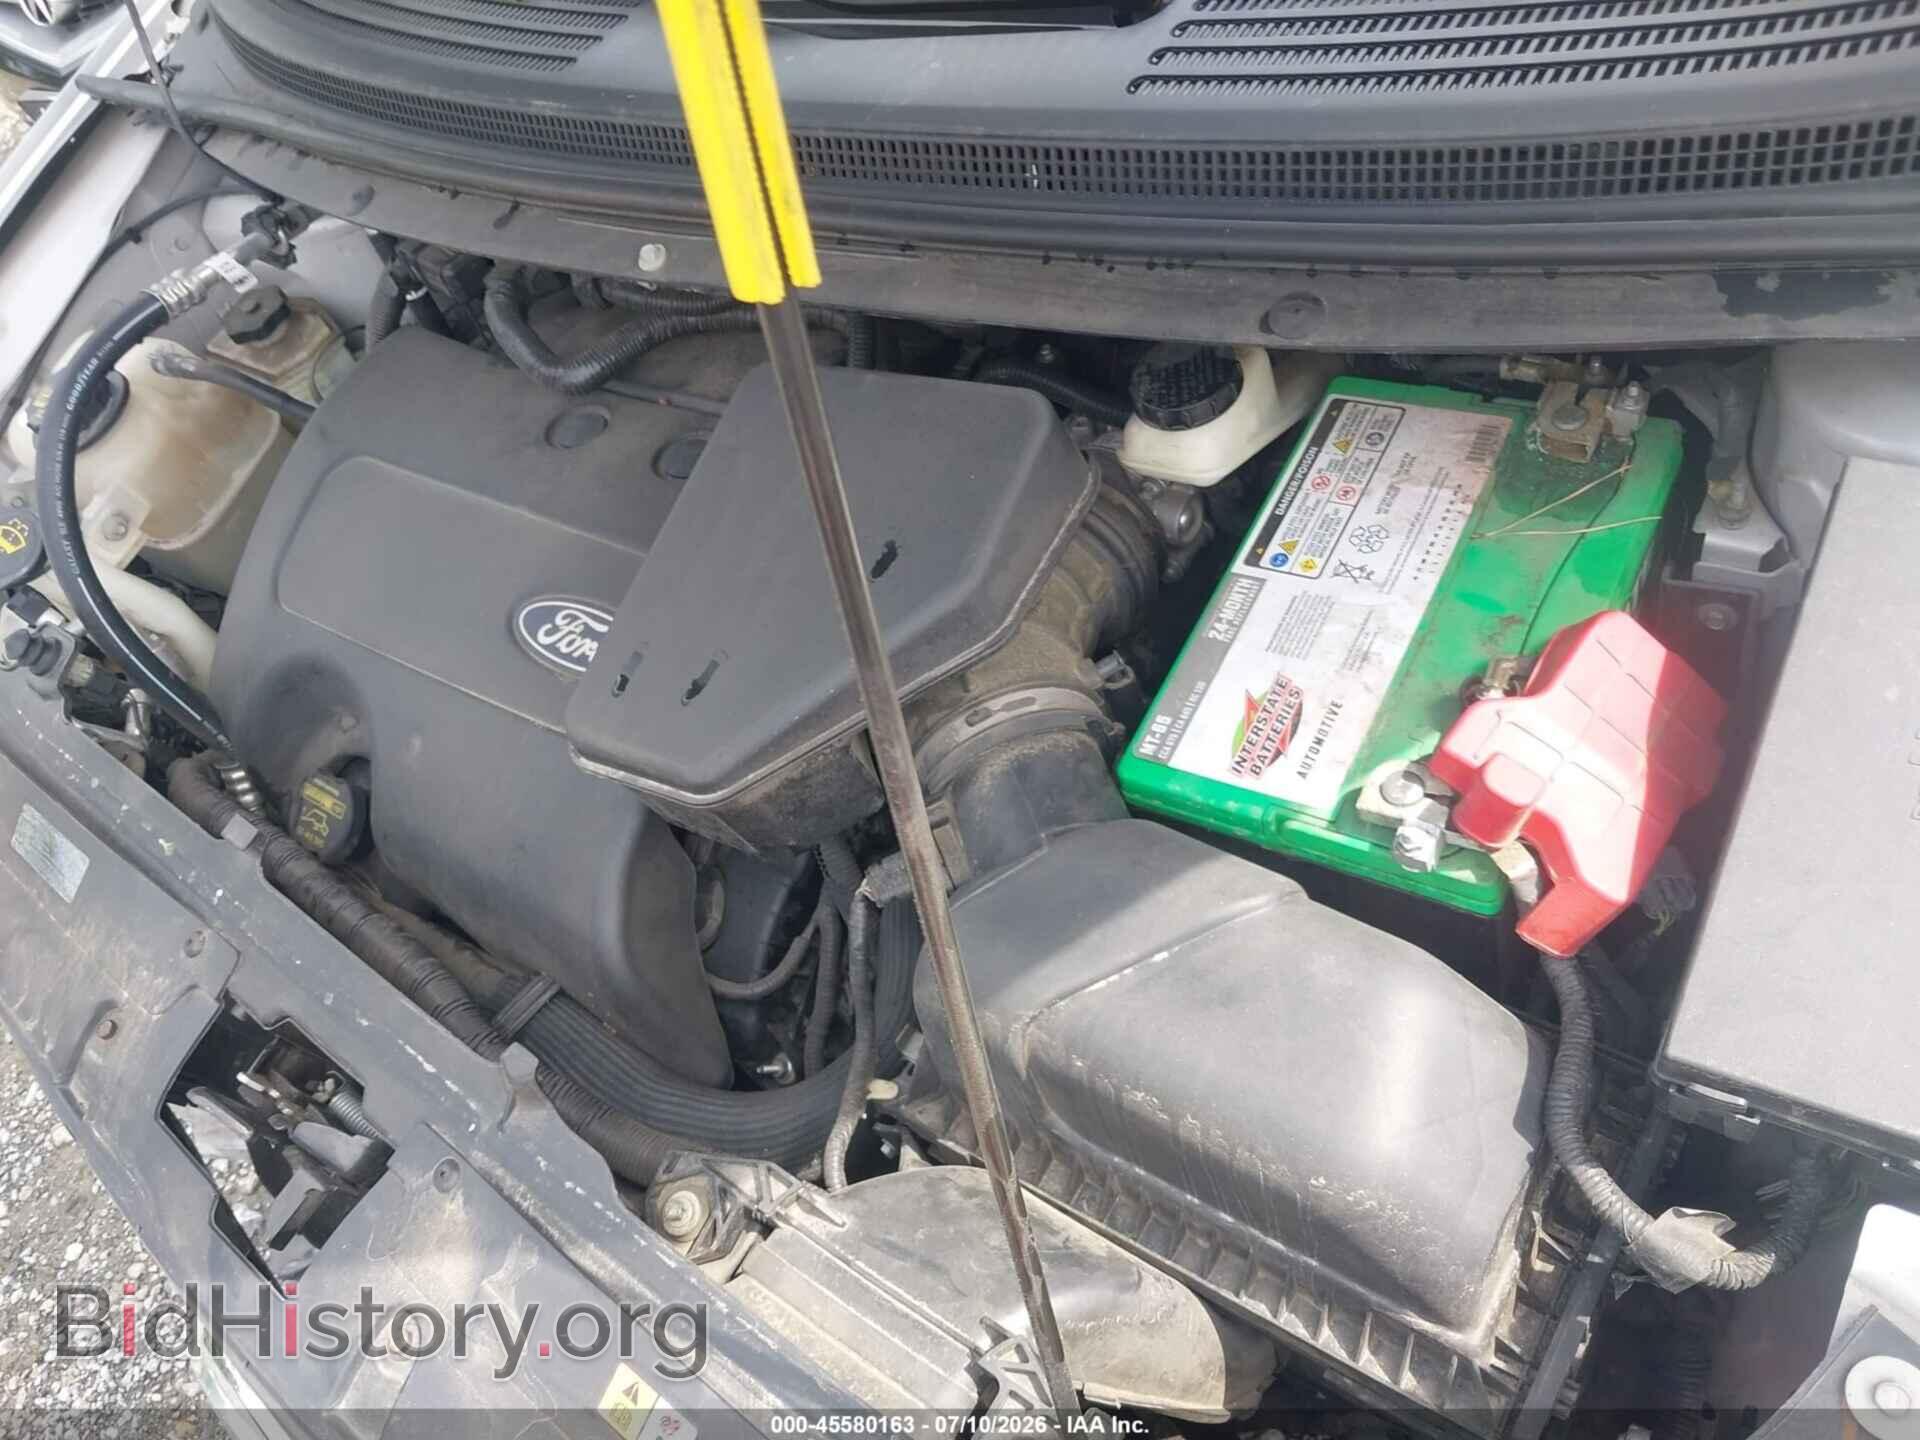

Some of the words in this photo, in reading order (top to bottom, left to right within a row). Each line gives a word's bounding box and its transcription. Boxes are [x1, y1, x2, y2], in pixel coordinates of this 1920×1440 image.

[66, 358, 98, 411] GOODYEAR
[1275, 446, 1319, 515] DANGER/POISON
[537, 609, 610, 662] For
[1208, 578, 1252, 641] 24-MONTH
[1231, 678, 1288, 774] INTERSTATE
[1249, 688, 1300, 776] BATTERIES
[1296, 700, 1343, 779] AUTOMOTIVE
